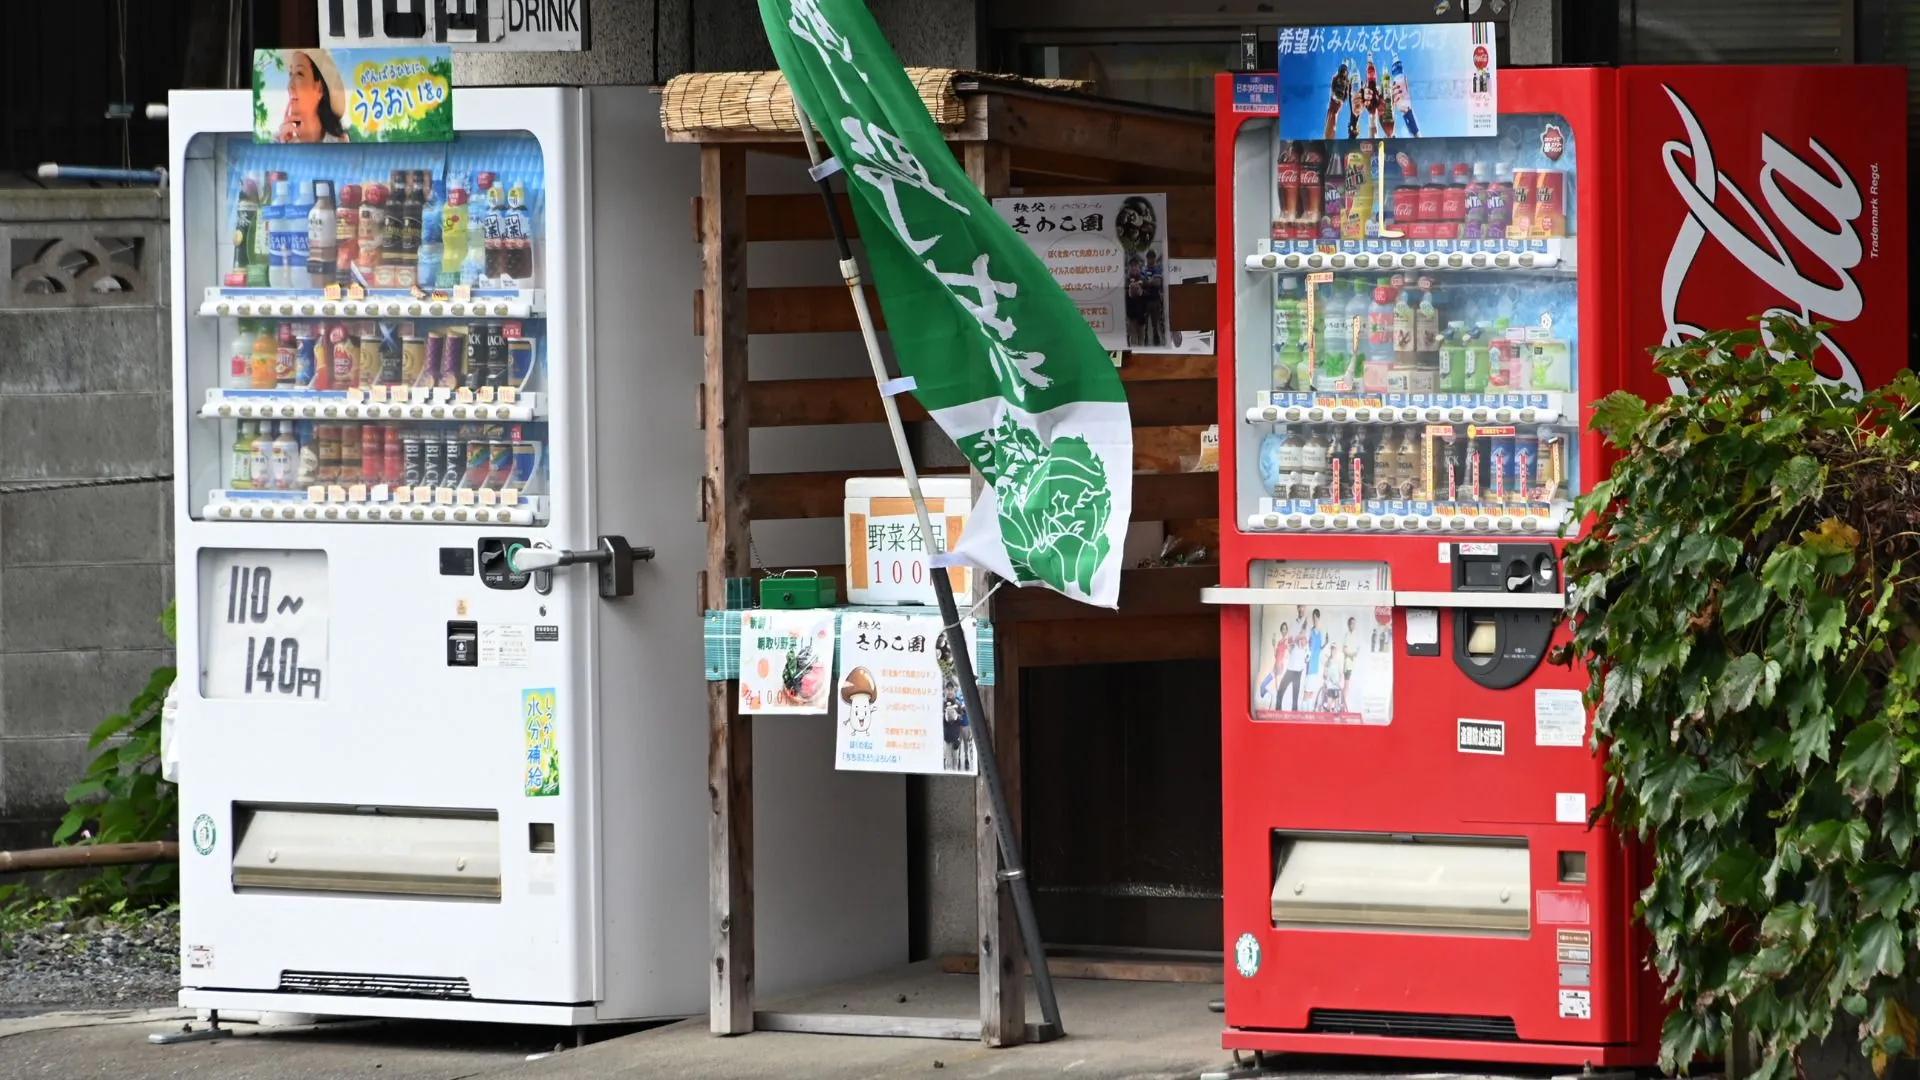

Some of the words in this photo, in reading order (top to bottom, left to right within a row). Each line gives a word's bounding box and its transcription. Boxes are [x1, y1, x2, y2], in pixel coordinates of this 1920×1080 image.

[508, 0, 580, 32] DRINK
[360, 63, 426, 85] がんばるひとに、
[355, 82, 444, 124] うるおいを。
[1870, 162, 1880, 195] Regd.
[1012, 213, 1104, 234] きのこ園
[1014, 202, 1045, 213] 秩父
[1870, 197, 1879, 259] Trademark
[874, 560, 934, 586] 100
[858, 620, 881, 631] 秩父
[856, 633, 926, 653] きのこ園
[245, 636, 321, 699] 140円
[543, 697, 553, 750] しっかり
[527, 695, 543, 788] 水分補給
